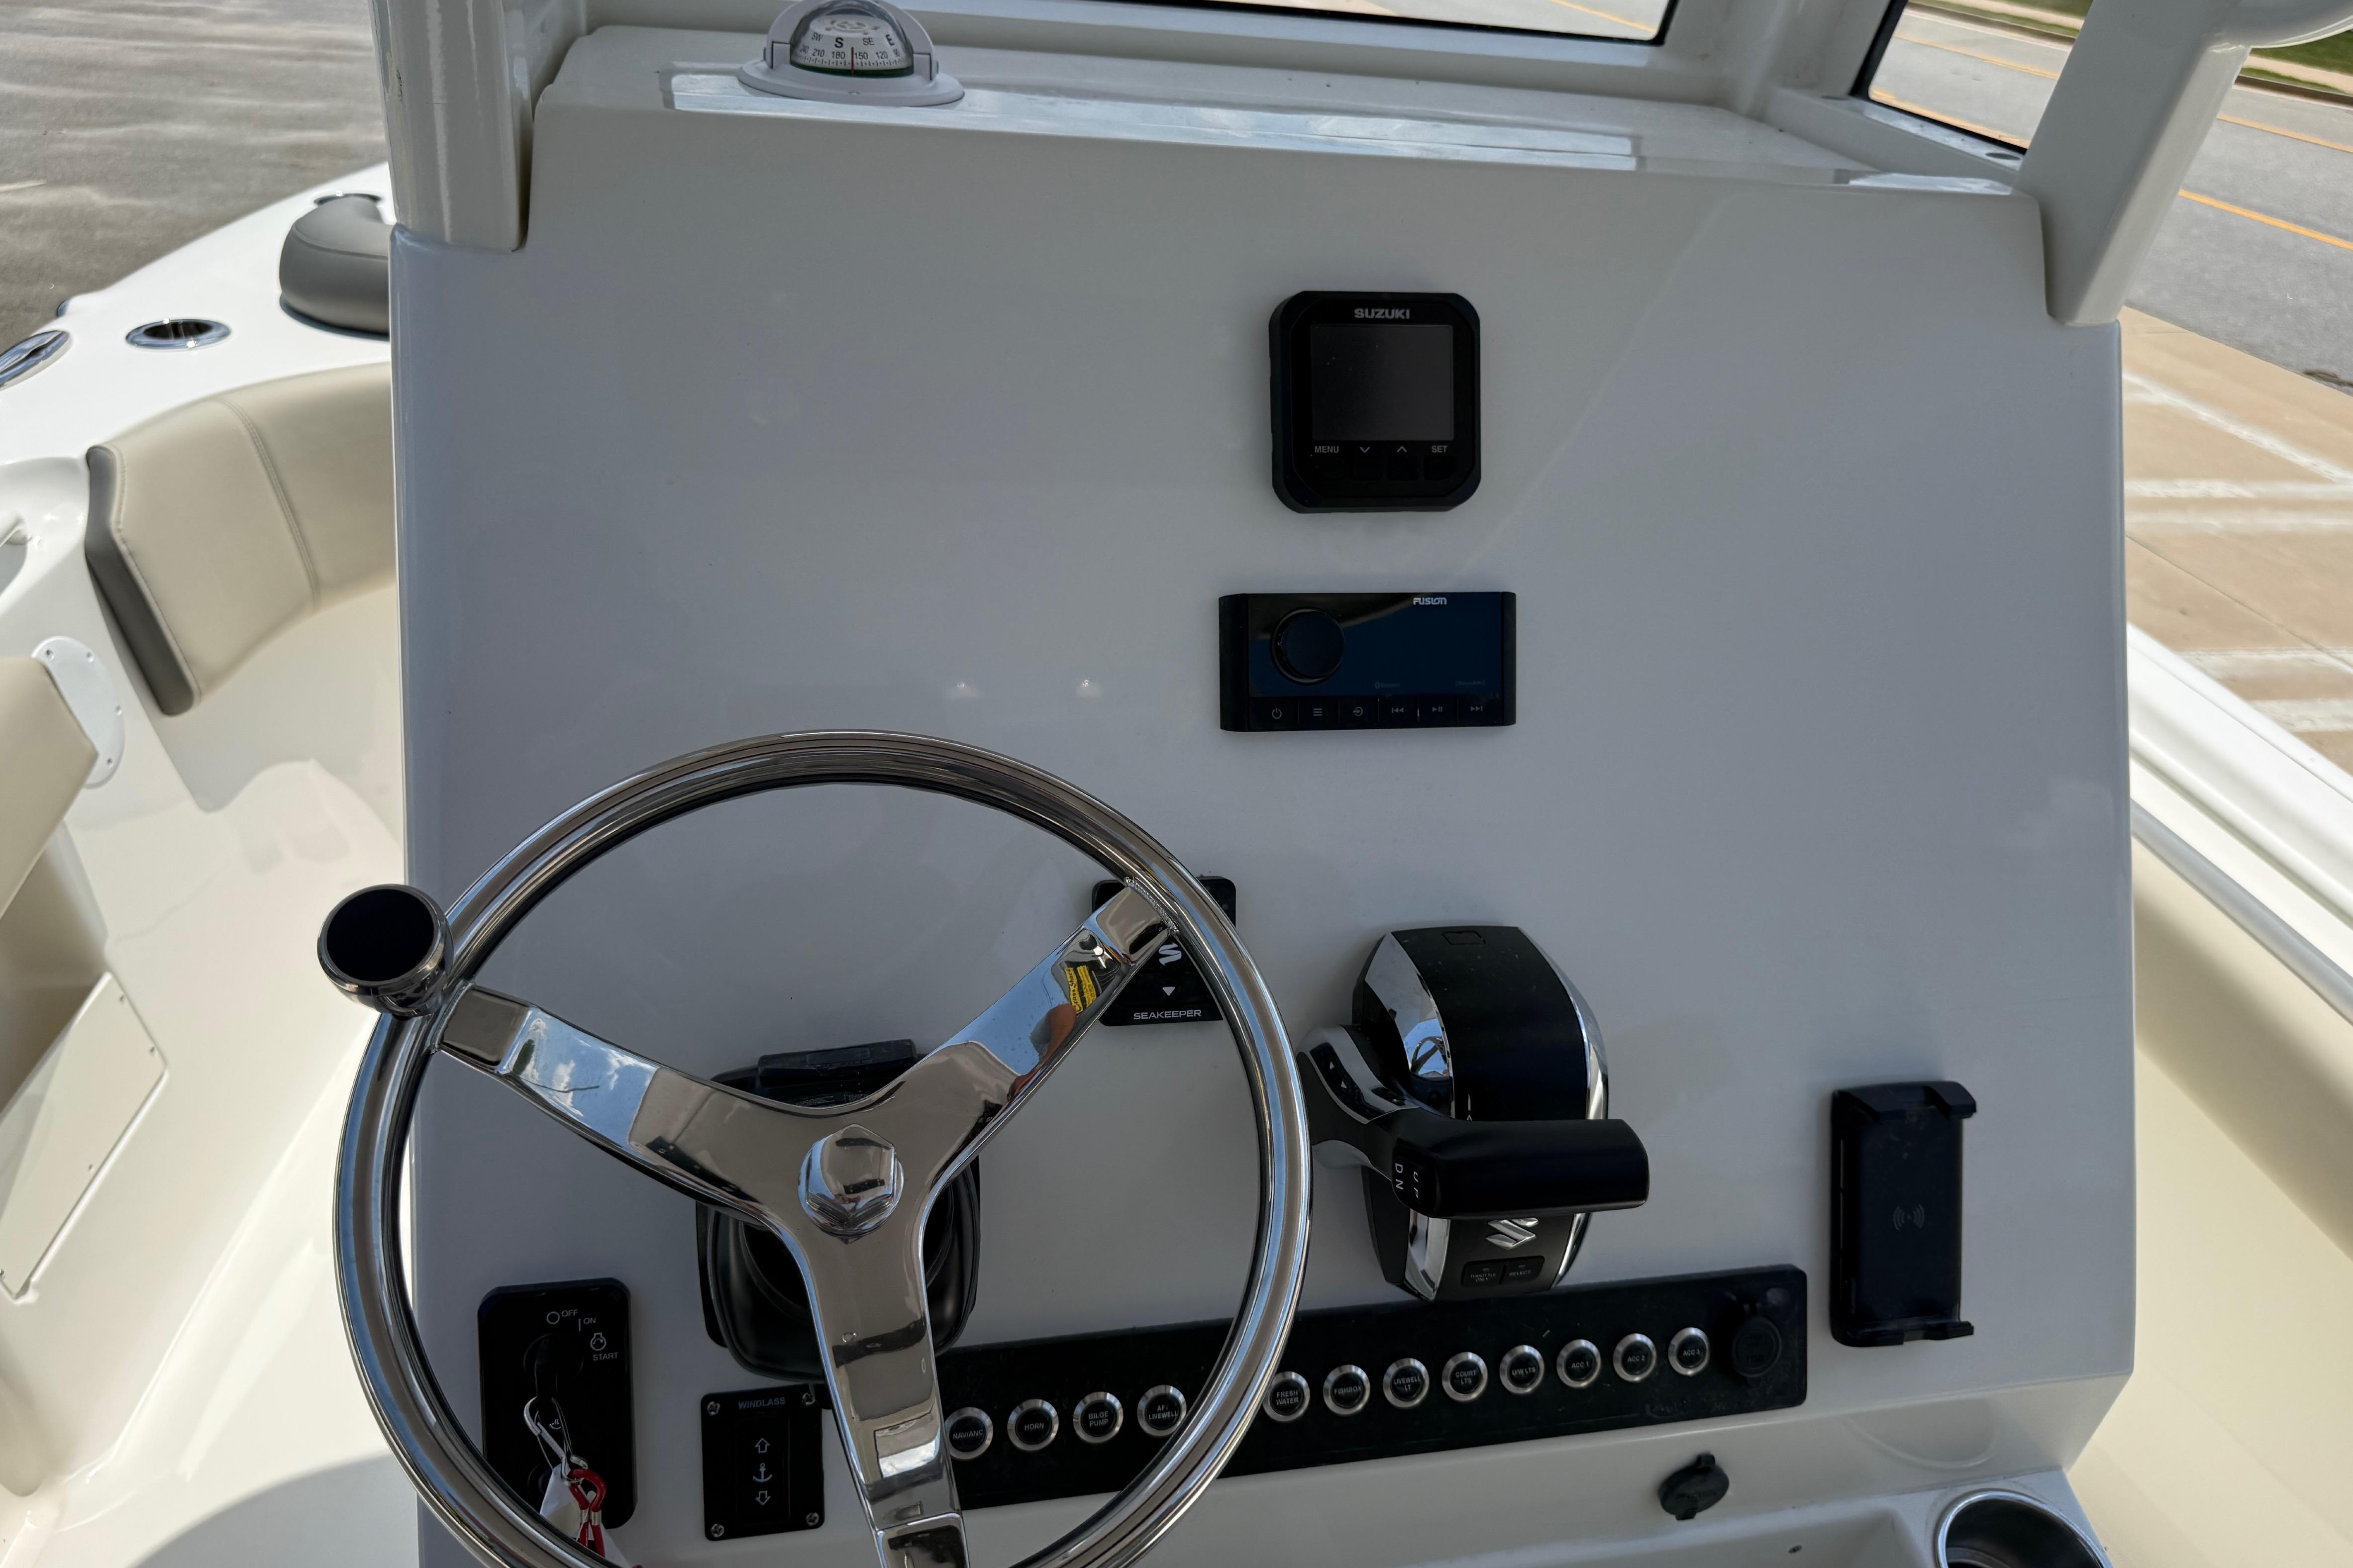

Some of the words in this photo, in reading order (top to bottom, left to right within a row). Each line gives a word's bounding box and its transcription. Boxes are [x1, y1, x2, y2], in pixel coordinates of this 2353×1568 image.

[812, 32, 823, 42] SW
[834, 37, 844, 48] S
[886, 34, 895, 46] E
[812, 48, 825, 57] 210
[831, 51, 846, 60] 180
[855, 51, 869, 60] 150
[876, 51, 888, 60] 120
[1354, 307, 1411, 319] SUZUKI
[1413, 597, 1447, 605] FUSION
[1133, 1009, 1202, 1020] SEAKEEPER
[561, 1309, 578, 1318] OFF
[593, 1352, 618, 1362] START
[1455, 1370, 1477, 1378] COURT
[1512, 1368, 1524, 1376] U/W
[1393, 1375, 1421, 1386] LIVEWELL
[1460, 1377, 1472, 1385] LTS
[1276, 1389, 1298, 1398] FRESH
[1334, 1385, 1362, 1395] FISHBOX
[738, 1397, 786, 1409] WINDLASS
[1276, 1397, 1299, 1406] WATER
[1088, 1411, 1109, 1420] BILGE
[1148, 1410, 1178, 1420] LIVEWELL
[1024, 1422, 1045, 1431] HORN
[1089, 1418, 1109, 1428] PUMP
[952, 1429, 984, 1440] NAV/ANC
